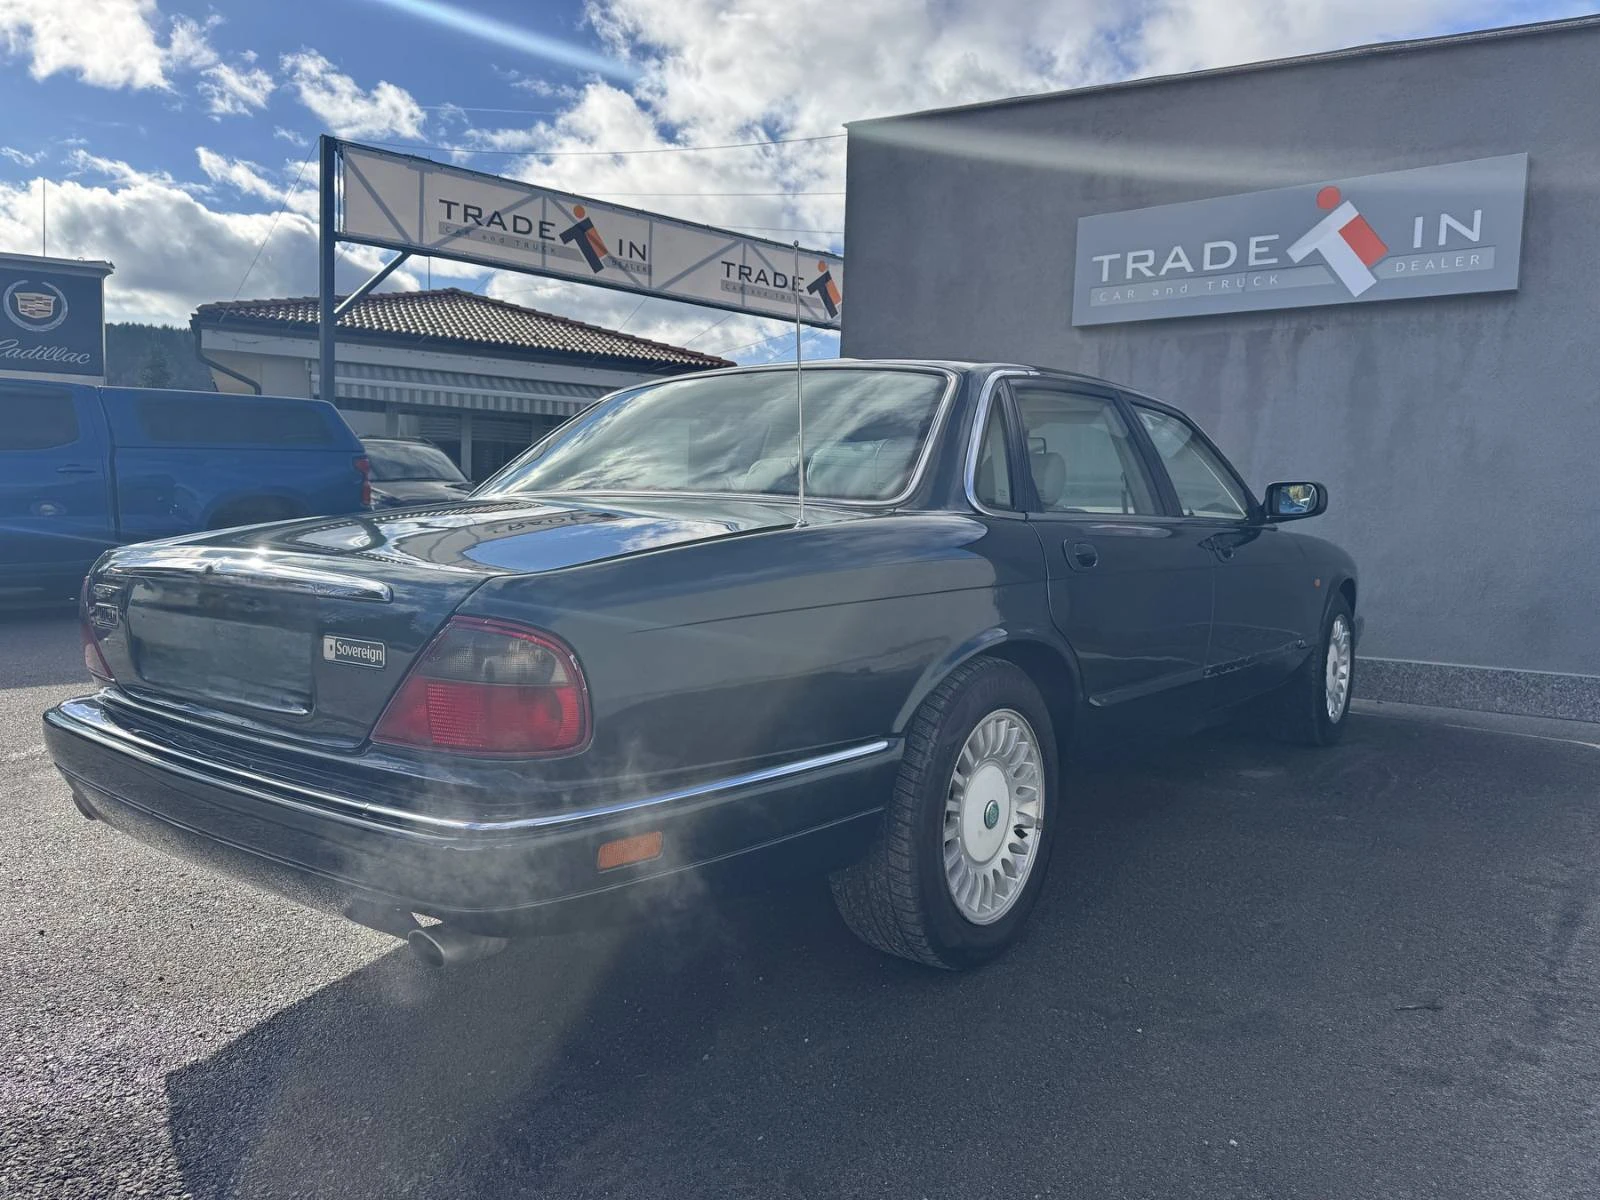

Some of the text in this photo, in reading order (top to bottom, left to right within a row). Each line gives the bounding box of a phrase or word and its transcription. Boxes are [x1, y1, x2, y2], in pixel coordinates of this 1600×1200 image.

[438, 199, 555, 241] TRADE
[618, 238, 646, 261] IN
[1091, 234, 1279, 282] TRADE
[1412, 209, 1482, 249] IN
[721, 260, 804, 292] TRADE
[1395, 254, 1480, 273] DEALER
[1099, 274, 1280, 302] CAR and TRUCK
[336, 641, 382, 662] Sovereign
